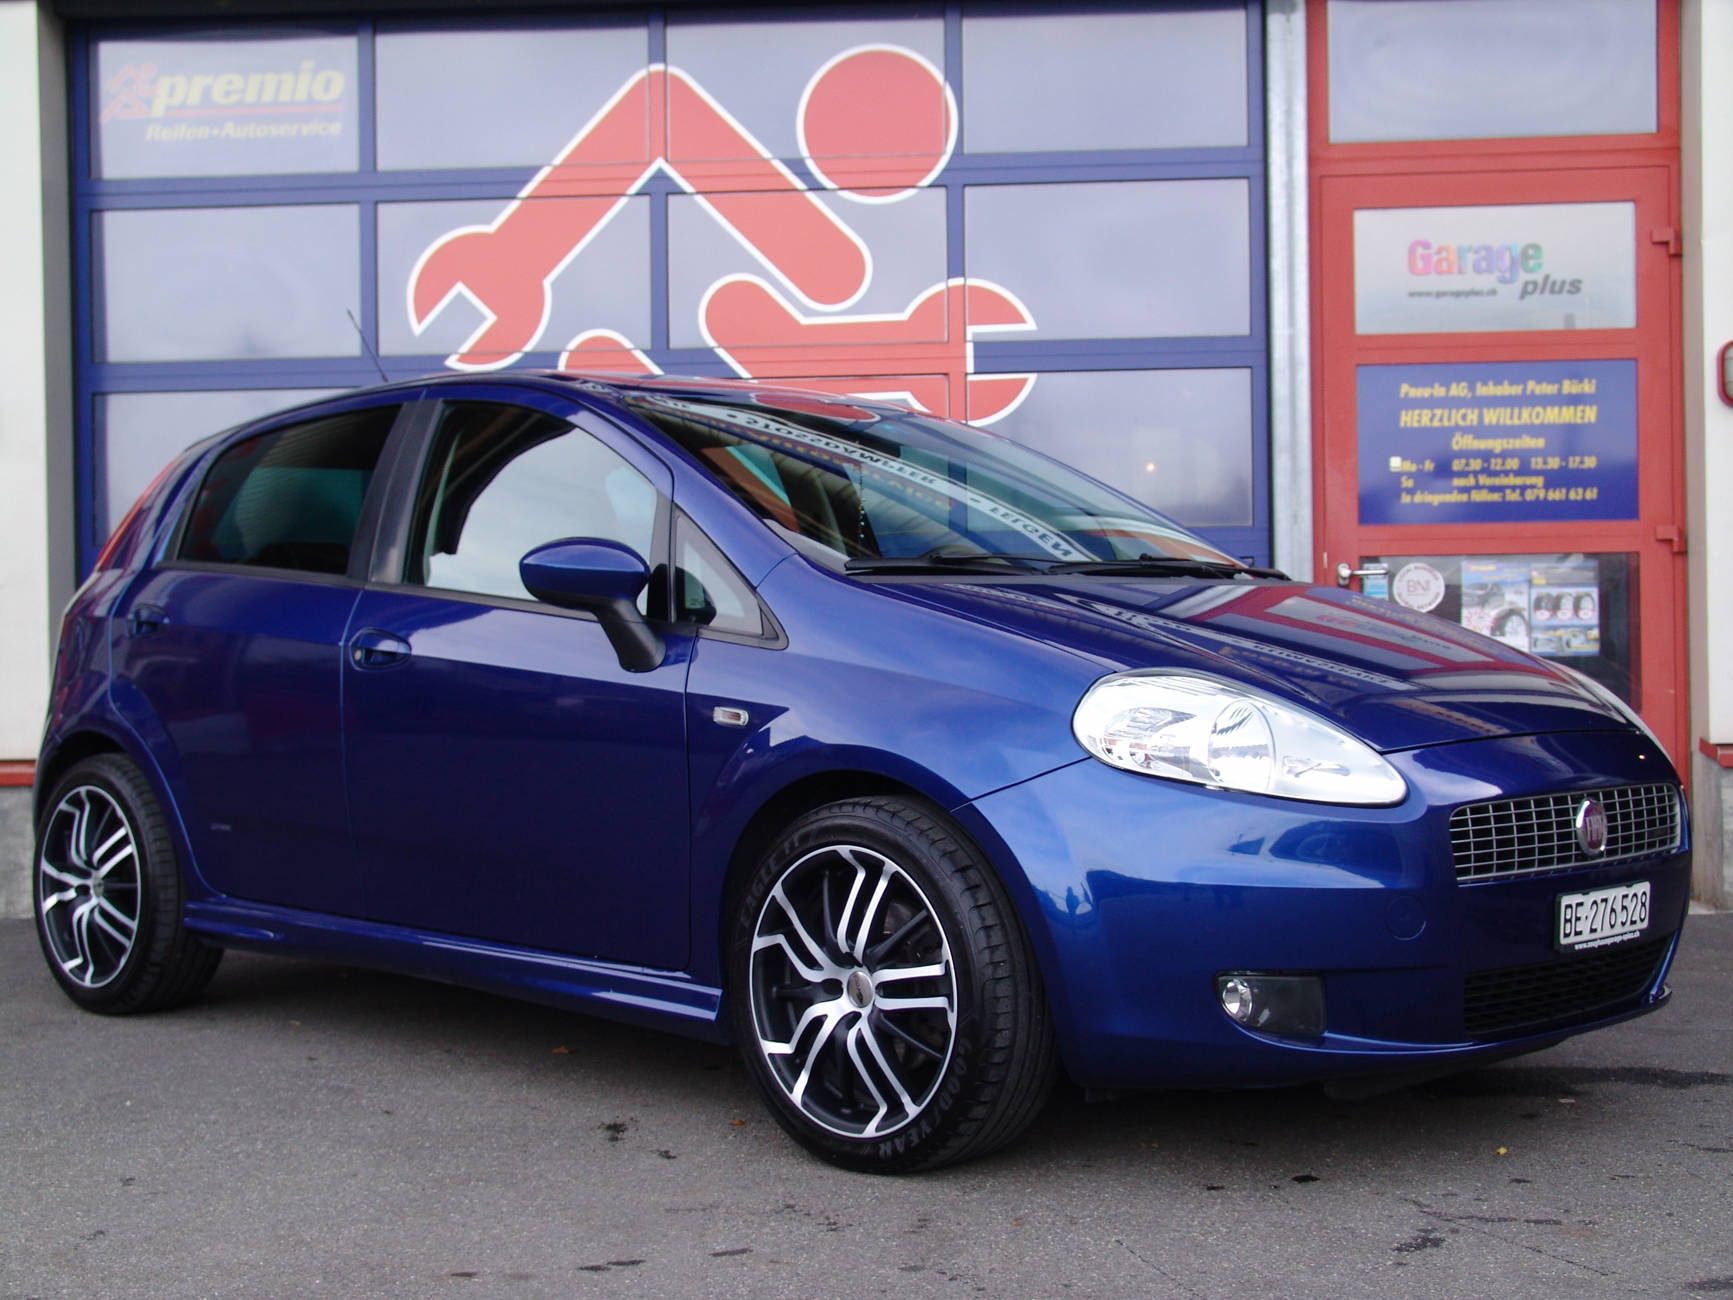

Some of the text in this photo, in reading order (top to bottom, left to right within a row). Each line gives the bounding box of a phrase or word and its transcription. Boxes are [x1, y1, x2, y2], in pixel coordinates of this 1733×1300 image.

[151, 59, 344, 117] premio
[1408, 239, 1543, 284] Garage
[1519, 274, 1583, 300] plus
[1476, 380, 1524, 397] Inhaber
[1526, 380, 1558, 396] Peter
[1562, 378, 1596, 394] Bürki
[1400, 405, 1597, 428] HERZLICH WILLKOMMEN
[1452, 432, 1545, 453] Öffnungszeiten
[1452, 474, 1476, 487] nach
[1478, 473, 1544, 488] Vereinbarung
[1414, 489, 1468, 506] dringenden
